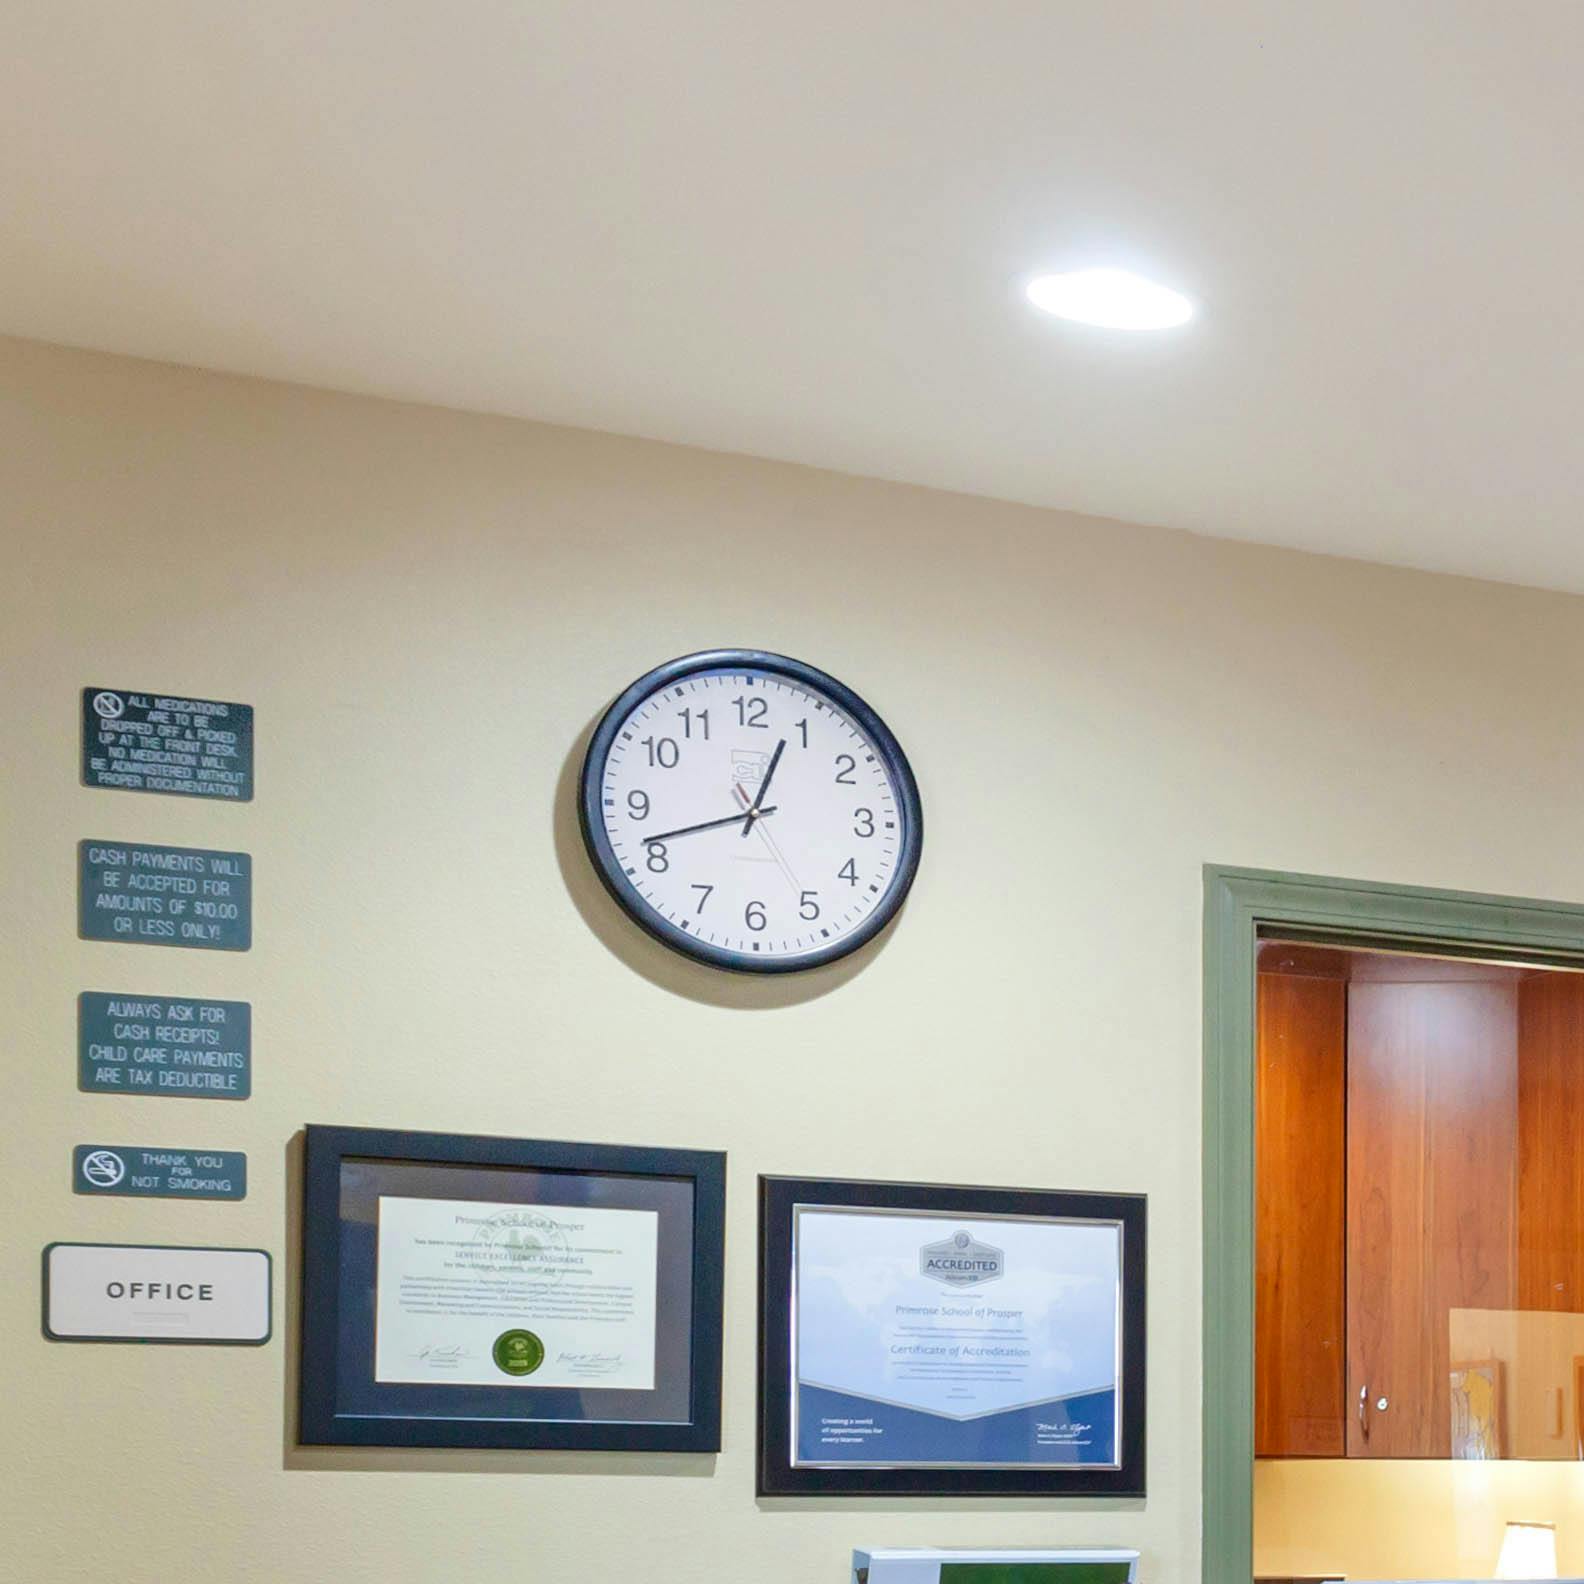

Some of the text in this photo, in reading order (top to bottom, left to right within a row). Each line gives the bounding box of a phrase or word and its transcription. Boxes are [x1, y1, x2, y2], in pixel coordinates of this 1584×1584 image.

[128, 695, 229, 717] ALL MEDICATIONS
[147, 710, 209, 728] ARE TO BE
[732, 695, 769, 729] 12
[101, 718, 154, 736] DROPPED
[157, 724, 180, 738] OFF
[196, 728, 237, 744] PICKED
[677, 707, 710, 741] 11
[795, 717, 808, 749] 1
[98, 731, 115, 745] UP
[118, 733, 135, 746] AT
[139, 735, 161, 750] THE
[165, 738, 201, 753] FRONT
[641, 735, 680, 769] 10
[90, 757, 247, 784] BE ADMINISTERED WITHOUT
[108, 746, 228, 770] NO MEDICATION WILL
[835, 753, 857, 785] 2
[97, 771, 143, 788] PROPER
[627, 789, 650, 821] 9
[853, 807, 875, 838] 3
[88, 847, 244, 877] CASH PAYMENTS WILL
[645, 841, 670, 874] 8
[103, 870, 231, 896] BE ACCEPTED FOR
[837, 857, 860, 888] 4
[95, 893, 239, 920] AMOUNTS OF $10.00
[690, 883, 714, 915] 7
[799, 890, 821, 921] 5
[113, 916, 222, 941] OR LESS ONLY!
[744, 901, 768, 932] 6
[106, 1000, 226, 1023] ALWAYS ASK FOR
[113, 1022, 220, 1046] CASH RECEIPTS!
[88, 1043, 245, 1069] CHILD CARE PAYMENTS
[95, 1066, 238, 1090] ARE TAX DEDUCTIBLE
[142, 1152, 224, 1169] THANK YOU
[170, 1166, 193, 1176] FOR
[131, 1176, 232, 1192] NOT SMOKING
[927, 1259, 998, 1272] ACCREDITED
[106, 1281, 214, 1302] OFFICE
[895, 1304, 939, 1316] Primrose
[941, 1305, 974, 1317] School
[974, 1307, 986, 1319] of
[890, 1344, 1031, 1358] Certificate of Accreditation
